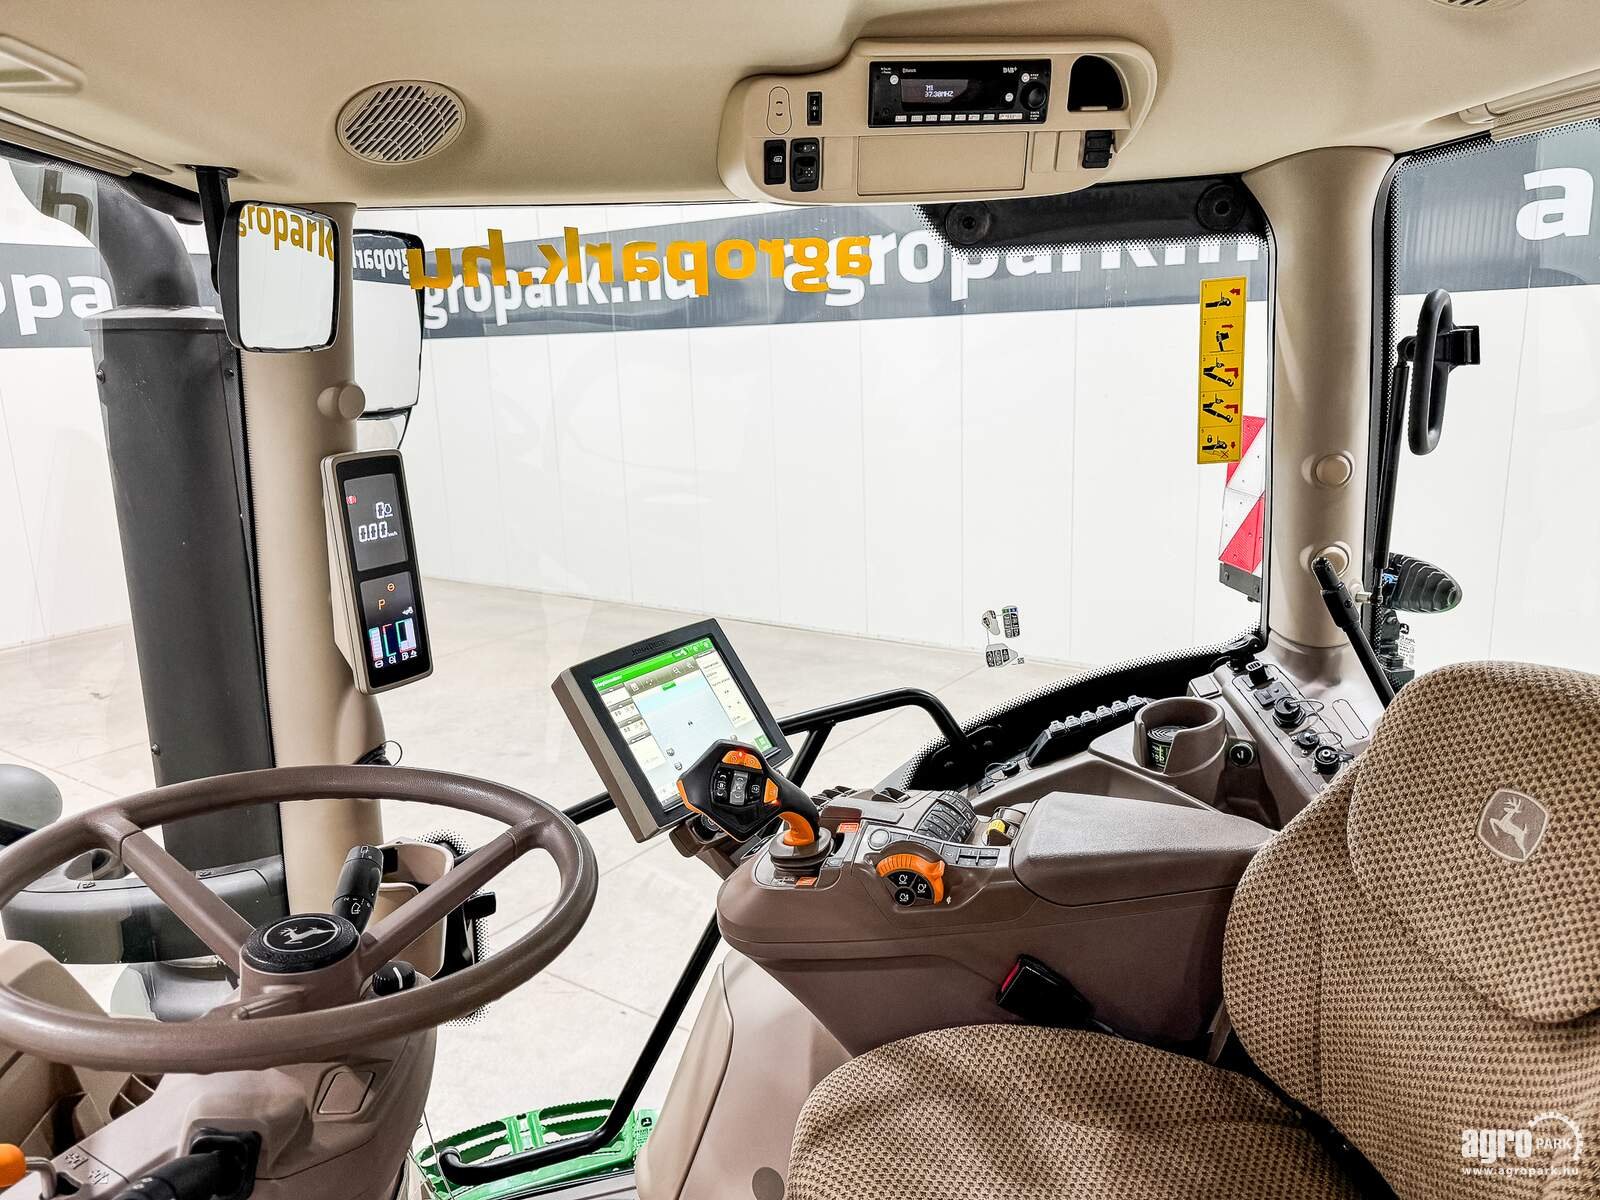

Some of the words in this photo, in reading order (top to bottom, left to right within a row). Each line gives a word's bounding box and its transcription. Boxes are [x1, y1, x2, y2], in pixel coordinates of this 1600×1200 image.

[1515, 167, 1594, 241] a
[0, 273, 114, 337] pa
[358, 520, 388, 543] 0.00
